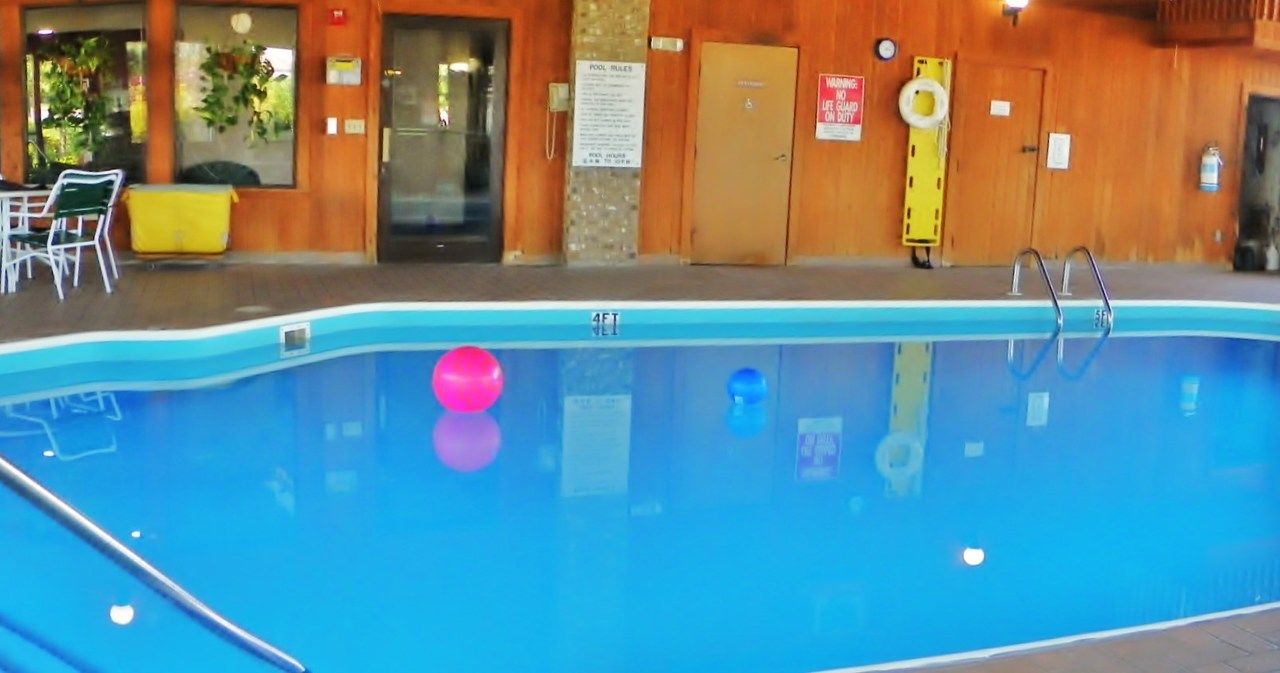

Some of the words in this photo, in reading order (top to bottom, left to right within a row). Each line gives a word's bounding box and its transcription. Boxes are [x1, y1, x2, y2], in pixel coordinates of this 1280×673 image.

[836, 90, 846, 100] NO
[822, 100, 834, 110] LIFE
[836, 101, 858, 112] GUARD
[825, 111, 835, 121] ON
[837, 111, 855, 122] DUTY
[593, 312, 618, 322] 4FT
